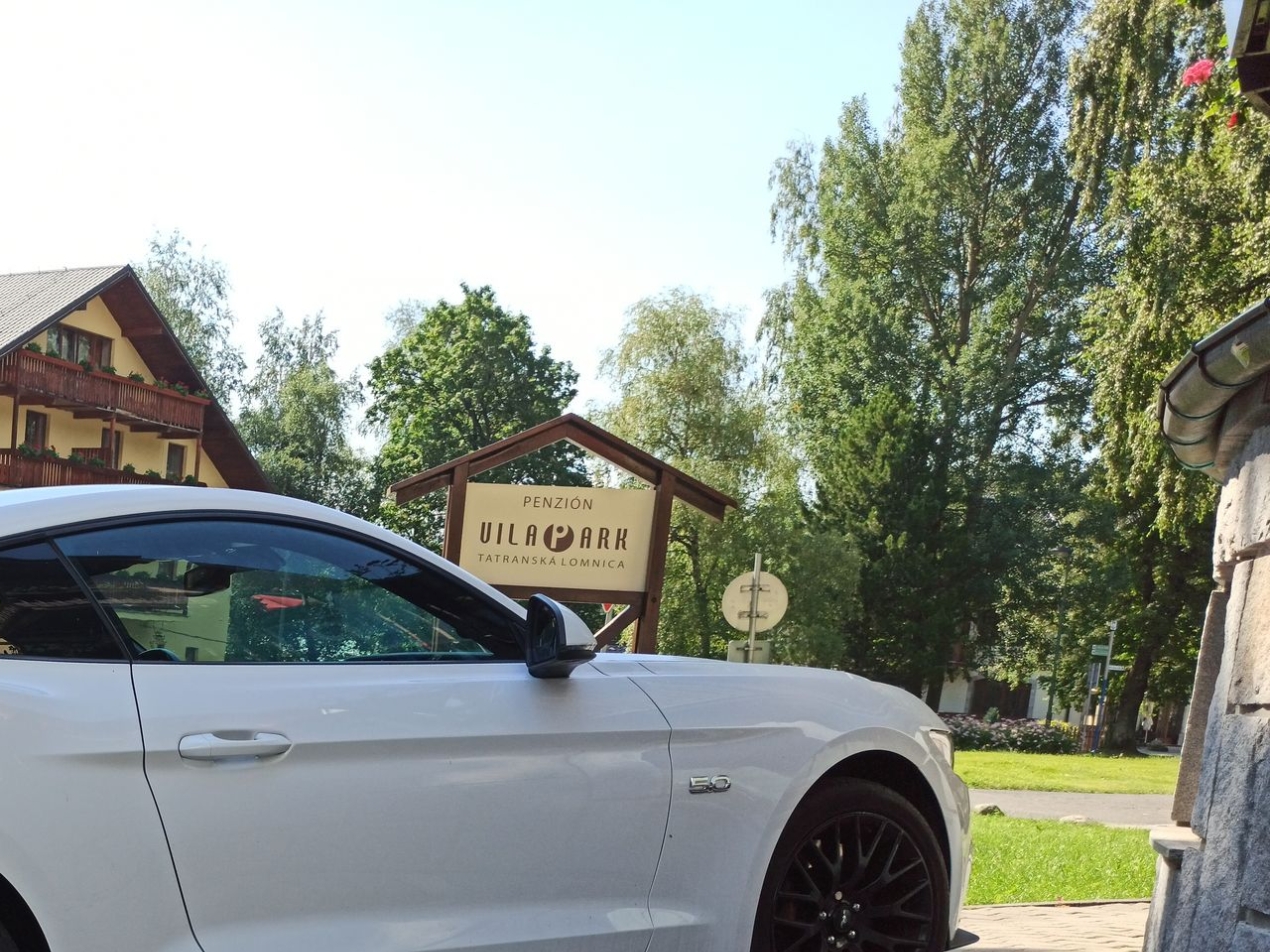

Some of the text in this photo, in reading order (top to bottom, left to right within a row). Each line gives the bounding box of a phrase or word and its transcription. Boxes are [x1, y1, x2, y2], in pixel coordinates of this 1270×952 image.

[523, 495, 593, 510] PENZIÓN
[477, 553, 625, 569] TATRANSKÁ LOMNICA
